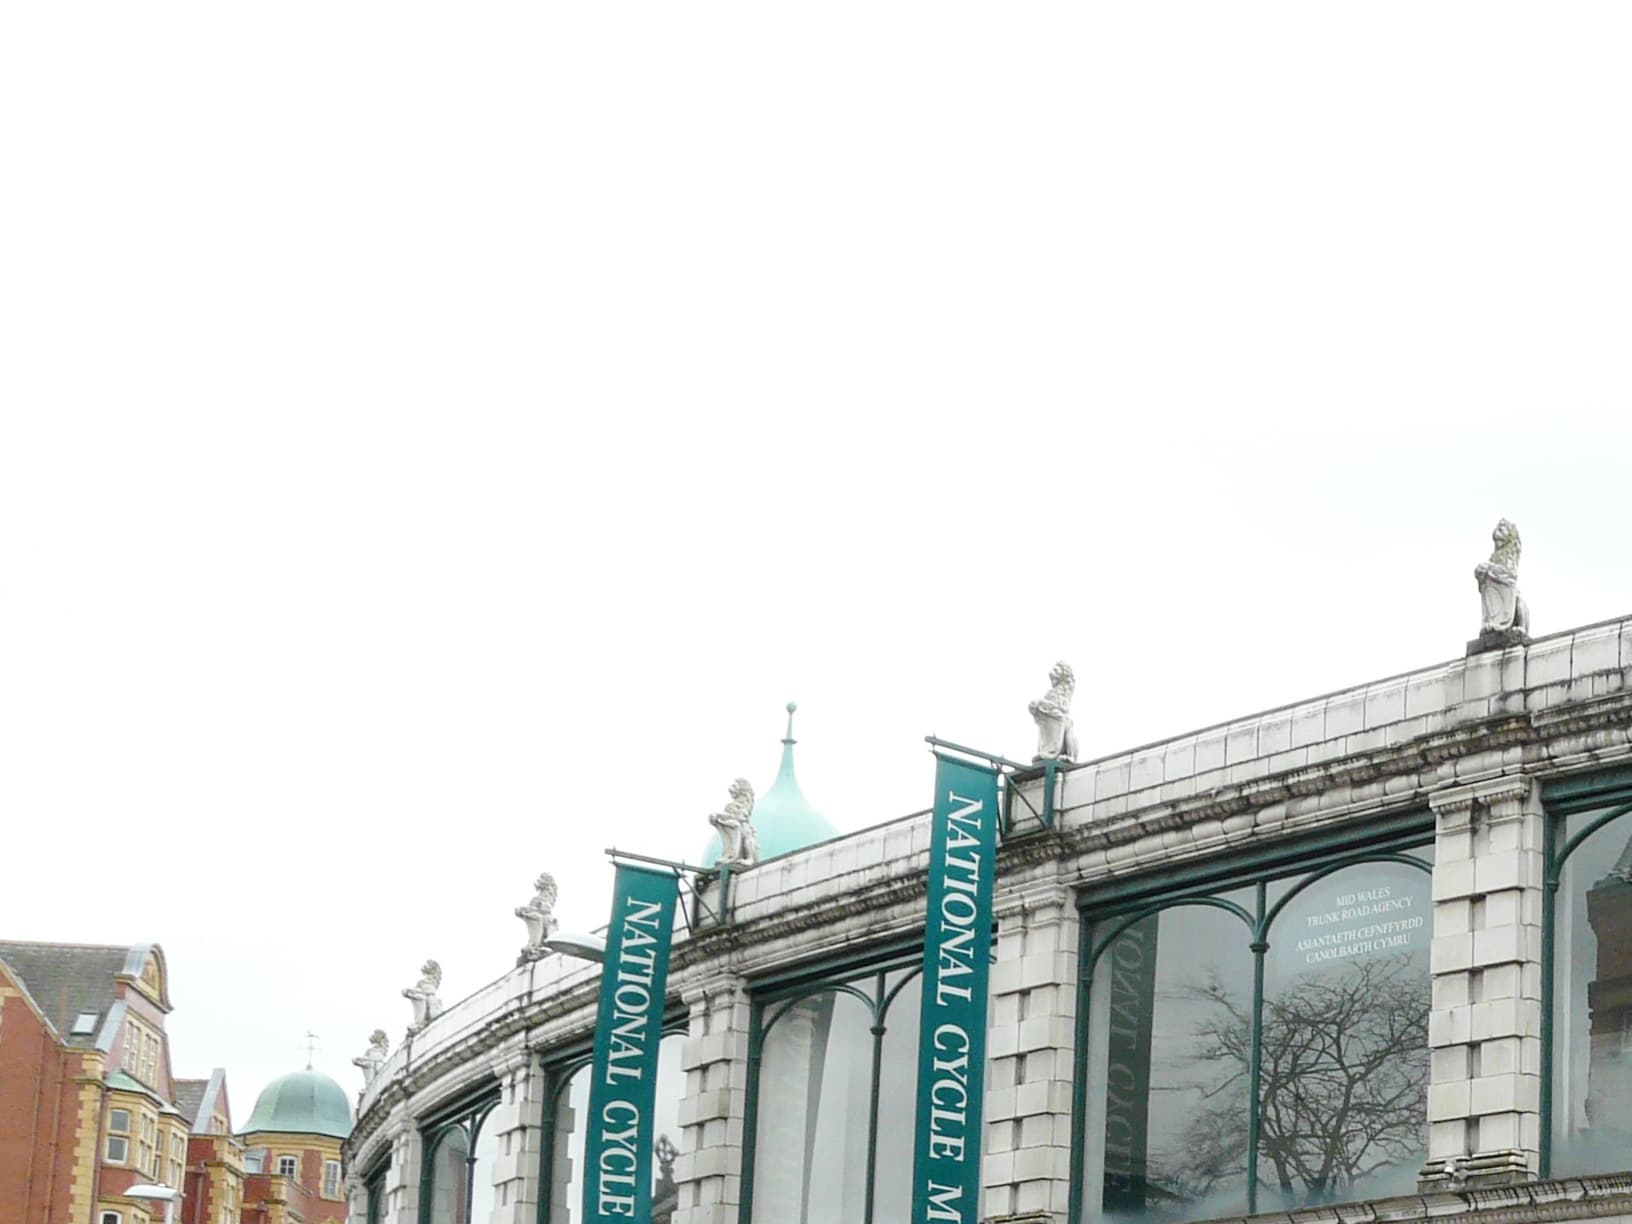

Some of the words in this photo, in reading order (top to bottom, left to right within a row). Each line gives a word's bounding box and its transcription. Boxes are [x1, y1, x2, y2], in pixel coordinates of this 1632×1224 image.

[936, 790, 984, 1007] NATIONAL
[1305, 913, 1340, 929] TRUNK
[1342, 905, 1370, 921] ROAD
[1370, 896, 1413, 914] AGENCY
[1336, 893, 1357, 907] MID
[1357, 886, 1391, 904] WALES
[1295, 930, 1356, 952] ASIANTAETH
[1305, 941, 1373, 964] CANOLBARTH
[1373, 932, 1412, 951] CYMRU
[607, 896, 662, 1085] NATIONAL
[928, 1024, 970, 1163] CYCLE
[599, 1099, 640, 1216] CYCLE
